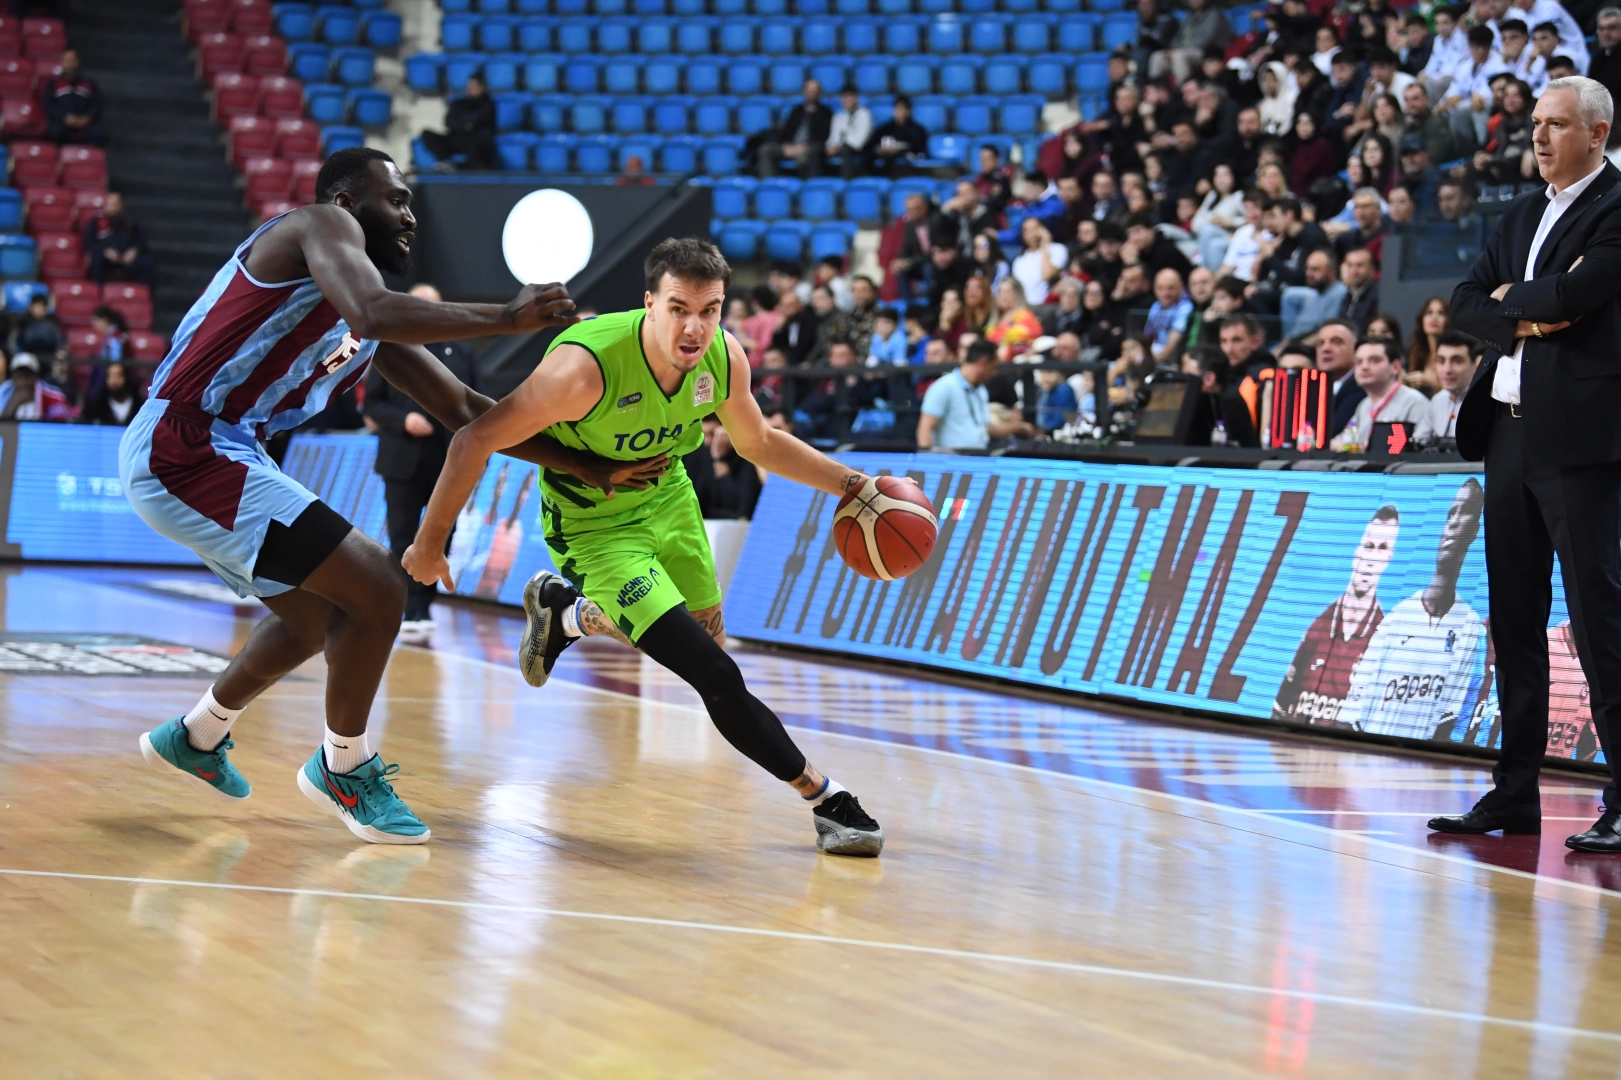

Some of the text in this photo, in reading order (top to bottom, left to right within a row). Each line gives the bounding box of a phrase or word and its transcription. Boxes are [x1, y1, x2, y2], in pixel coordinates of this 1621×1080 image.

[322, 331, 361, 374] 15
[614, 418, 700, 452] TOFA
[1294, 690, 1343, 724] papar
[1381, 674, 1445, 711] papara
